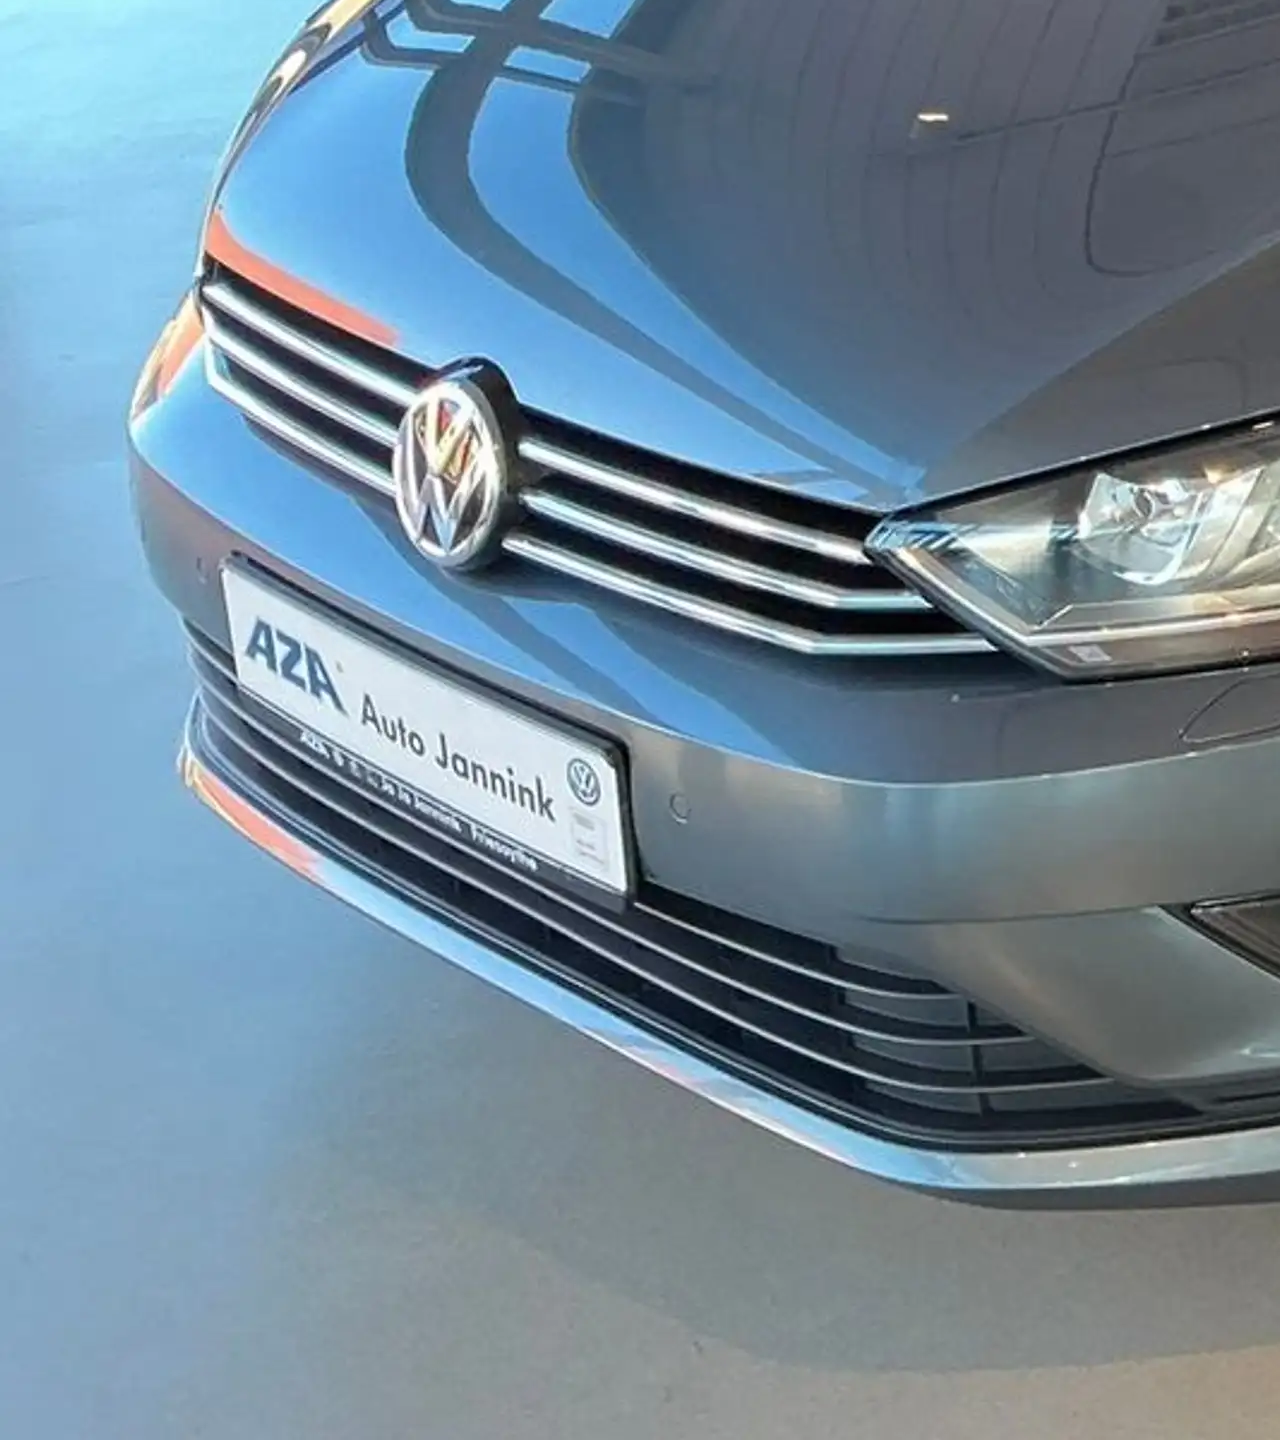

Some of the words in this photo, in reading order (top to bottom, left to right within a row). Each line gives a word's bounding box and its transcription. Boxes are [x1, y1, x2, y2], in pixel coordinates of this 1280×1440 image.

[244, 615, 349, 718] AZA
[360, 693, 425, 758] Auto
[434, 733, 557, 824] Jannink
